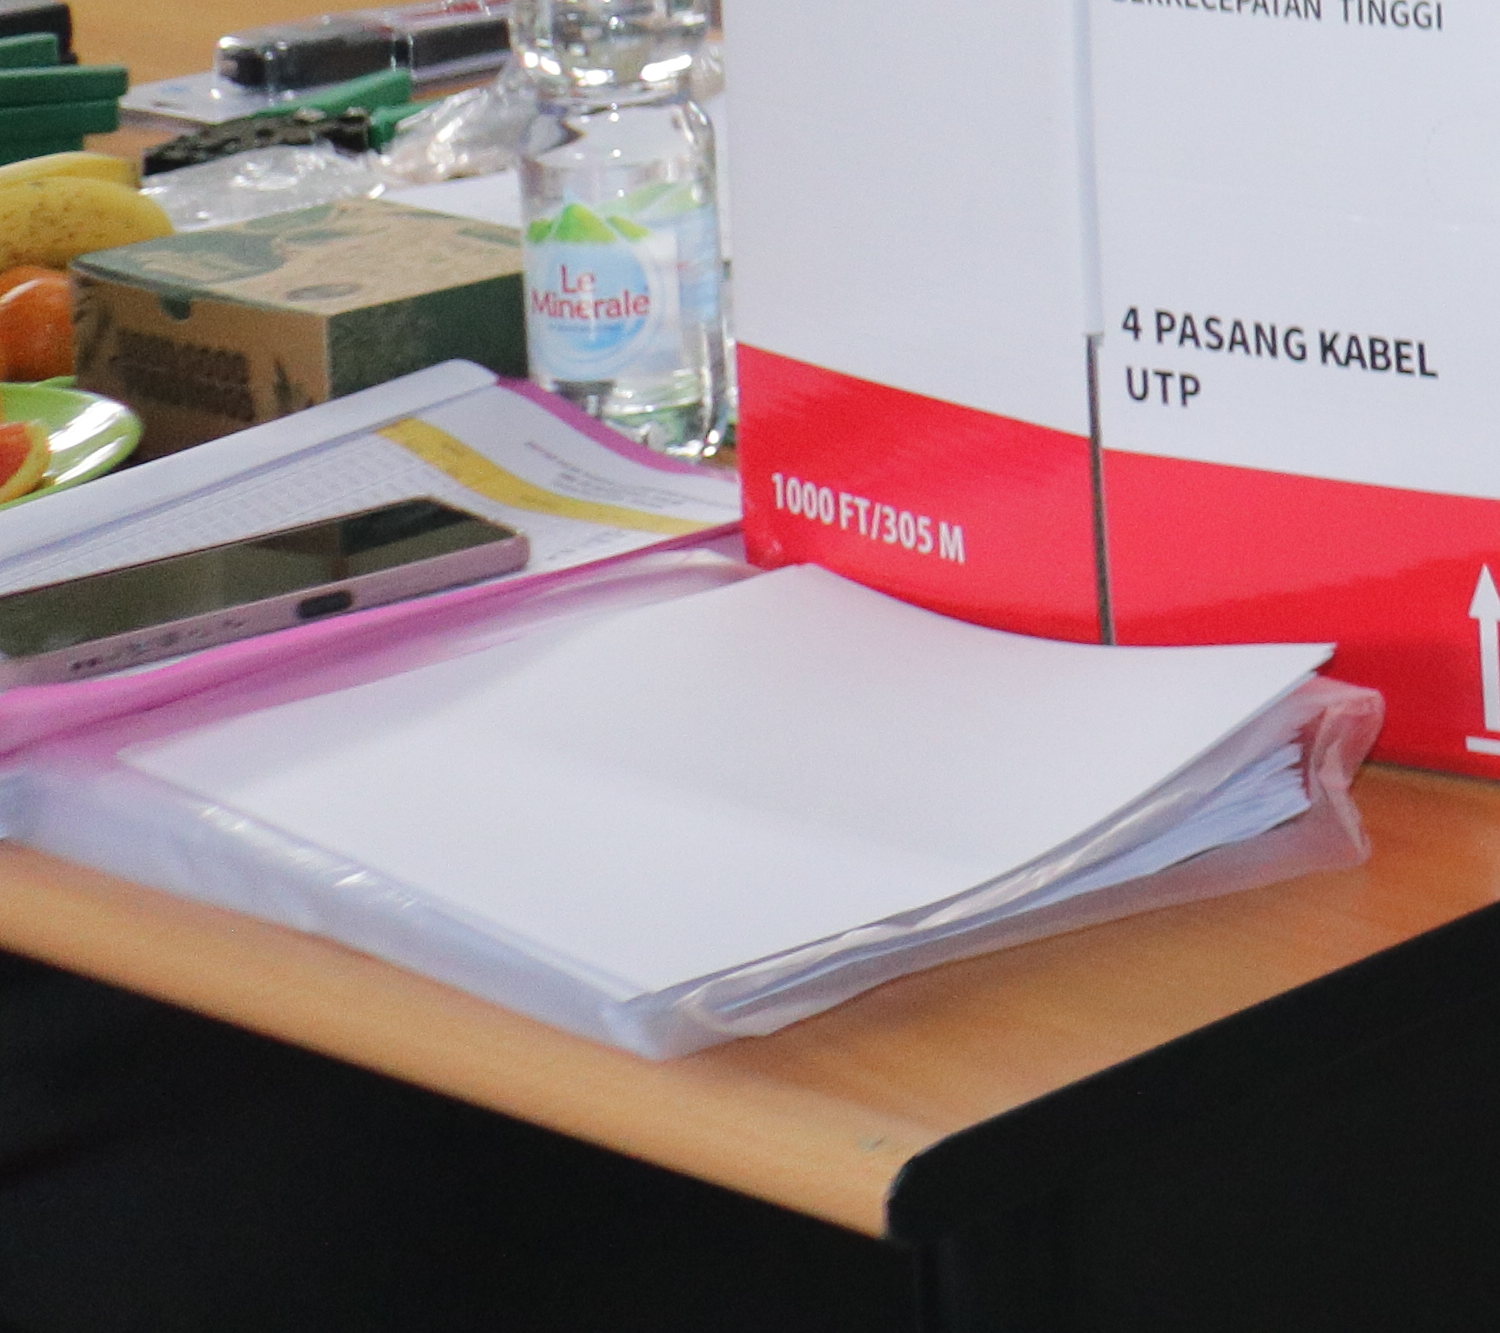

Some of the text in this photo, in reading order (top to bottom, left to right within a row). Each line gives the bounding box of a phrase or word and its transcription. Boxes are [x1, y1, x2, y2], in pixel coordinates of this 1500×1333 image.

[560, 263, 596, 295] Le
[531, 288, 650, 320] Minerale
[1122, 305, 1439, 379] 4 PASANG KABEL
[1125, 365, 1201, 407] UTP
[772, 471, 966, 565] 1000 FT/305 M
